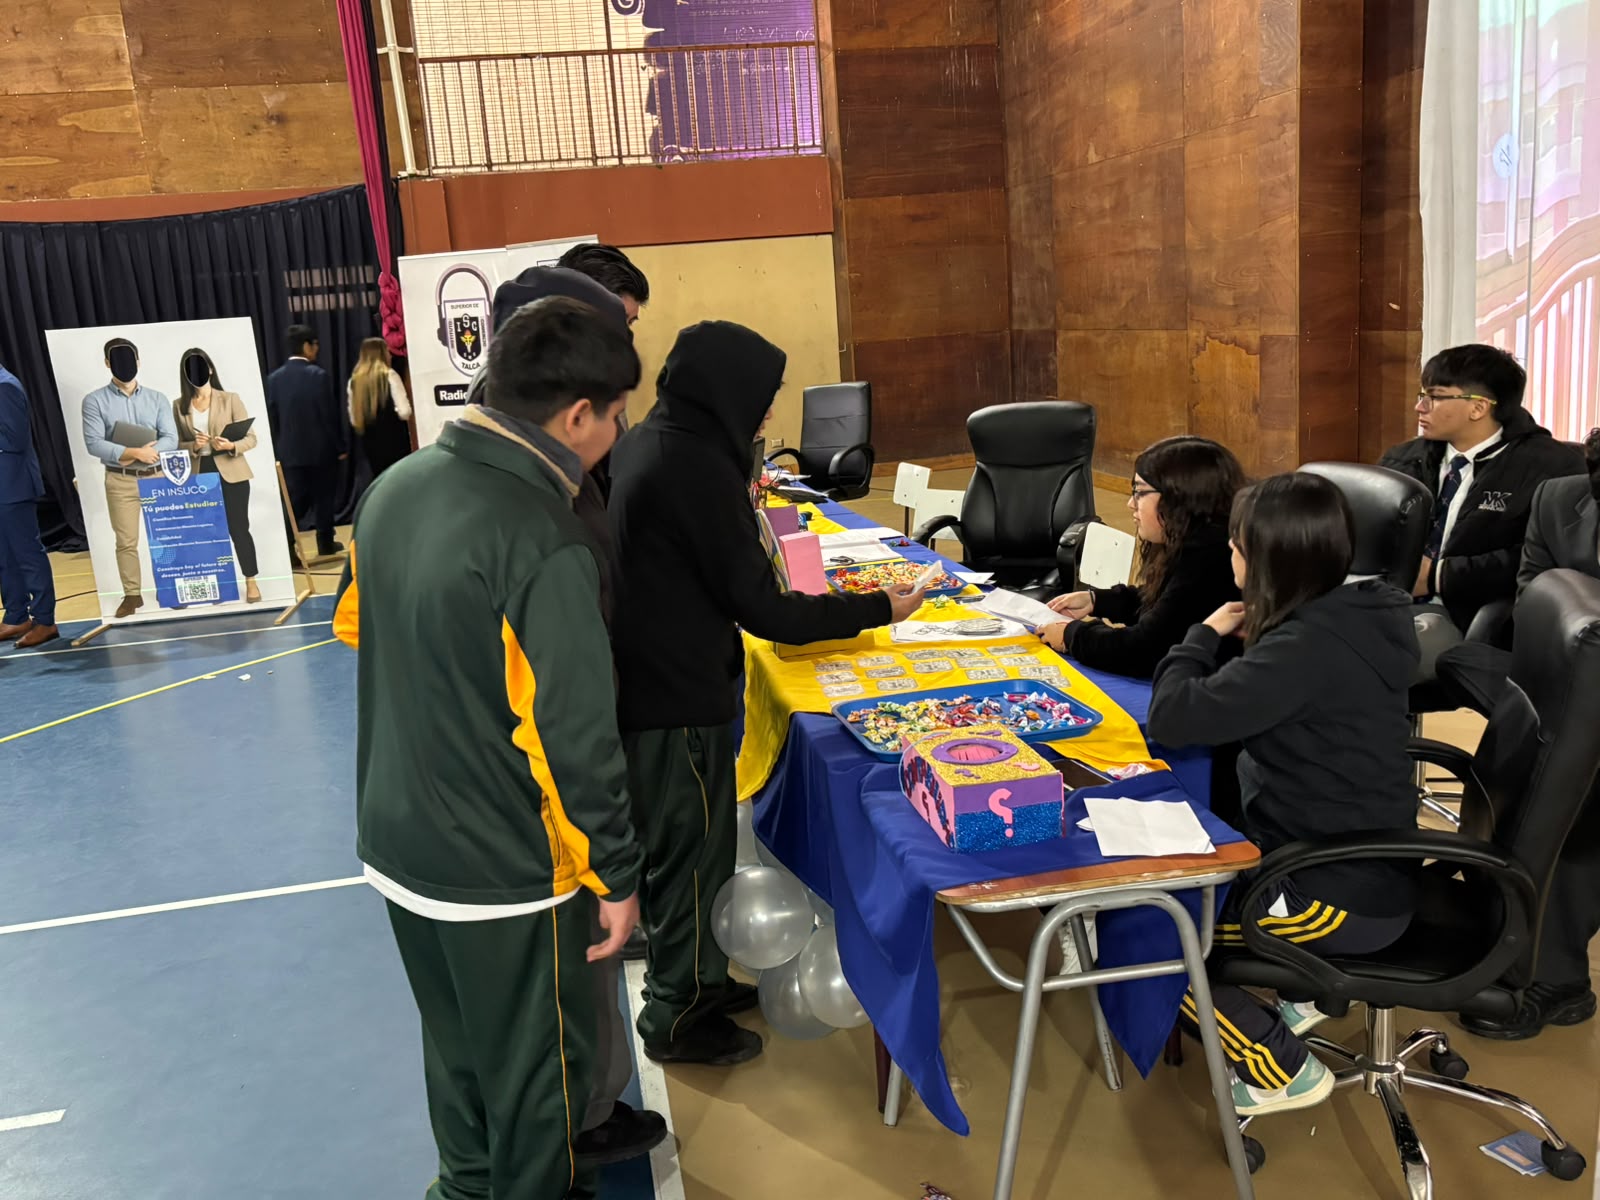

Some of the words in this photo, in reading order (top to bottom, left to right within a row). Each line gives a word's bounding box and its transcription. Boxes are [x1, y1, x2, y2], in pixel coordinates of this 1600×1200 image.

[461, 362, 481, 370] TALCA
[151, 489, 165, 497] EN
[168, 485, 208, 496] INSUCO
[155, 503, 184, 513] puedes
[184, 501, 218, 509] Estudiar
